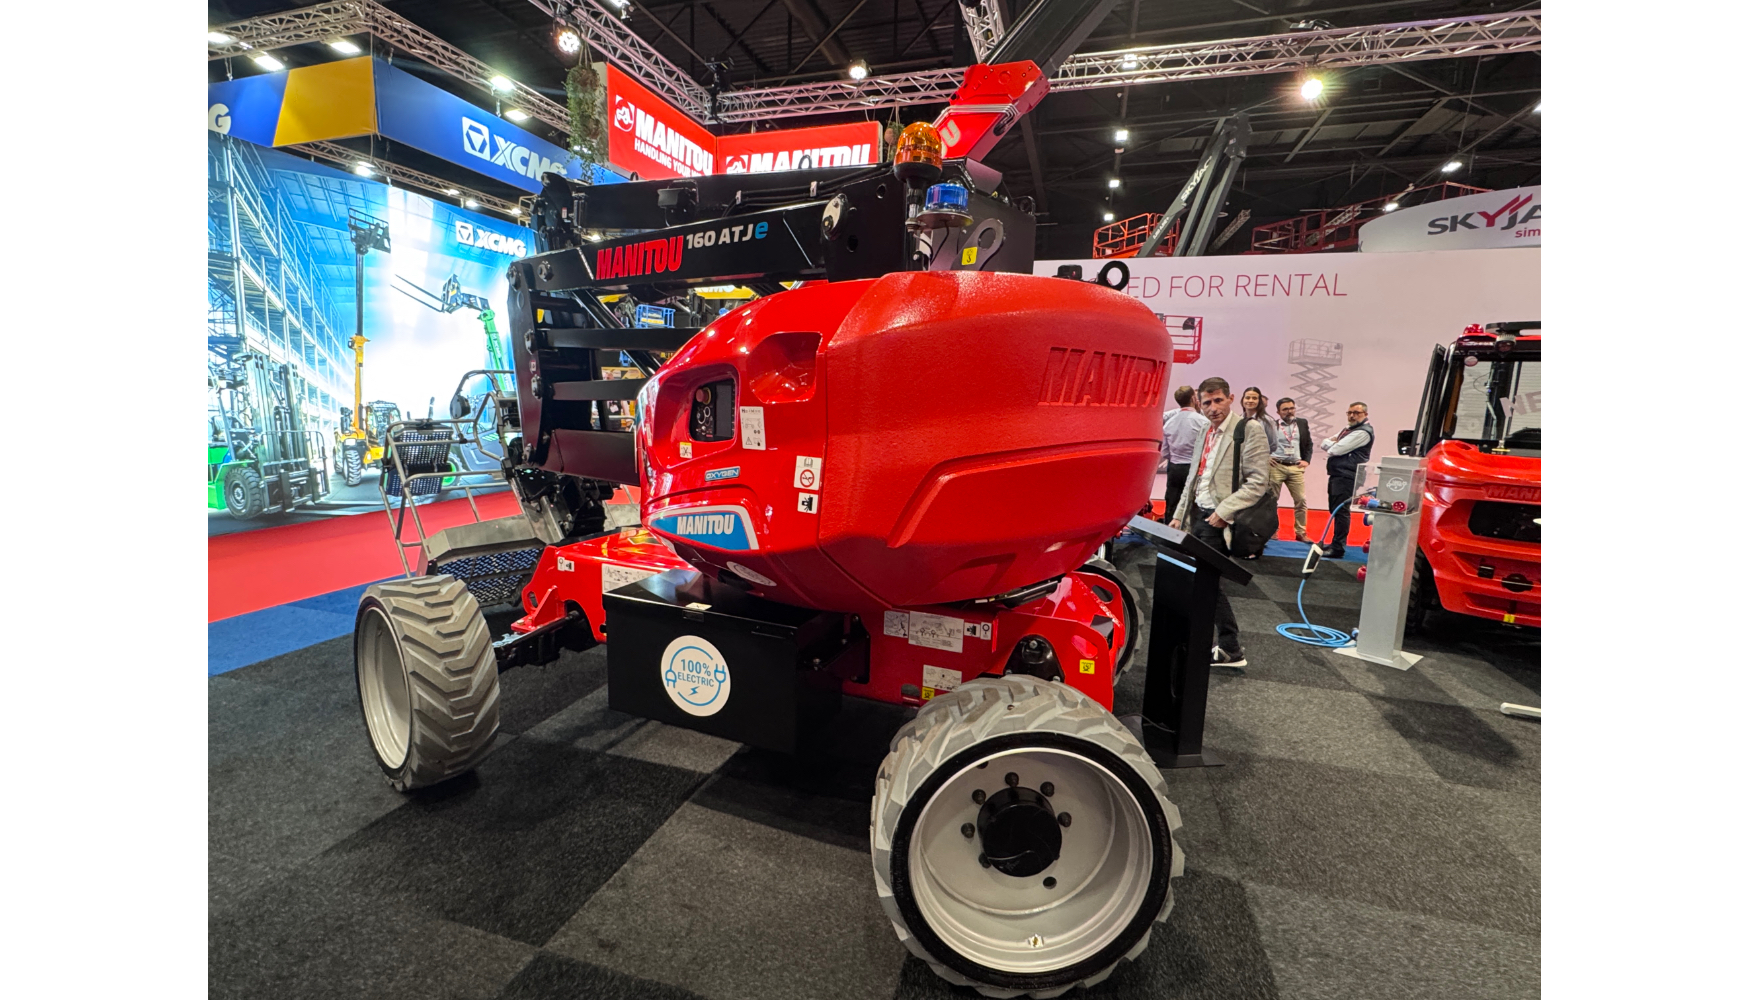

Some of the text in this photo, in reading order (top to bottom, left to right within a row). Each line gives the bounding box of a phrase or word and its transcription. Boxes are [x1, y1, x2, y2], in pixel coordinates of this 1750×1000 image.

[635, 108, 713, 176] MANITOU
[941, 119, 961, 157] U
[634, 138, 673, 170] HANDLING
[474, 228, 527, 258] XCMG
[1514, 227, 1541, 239] sim
[596, 235, 684, 280] MANITOU
[686, 231, 716, 249] 160
[1169, 275, 1224, 298] FOR
[1235, 273, 1347, 297] RENTAL
[705, 469, 739, 480] OXYGEN
[677, 514, 735, 535] MANITOU
[678, 671, 714, 688] ELECTRIC
[681, 659, 711, 677] 100%
